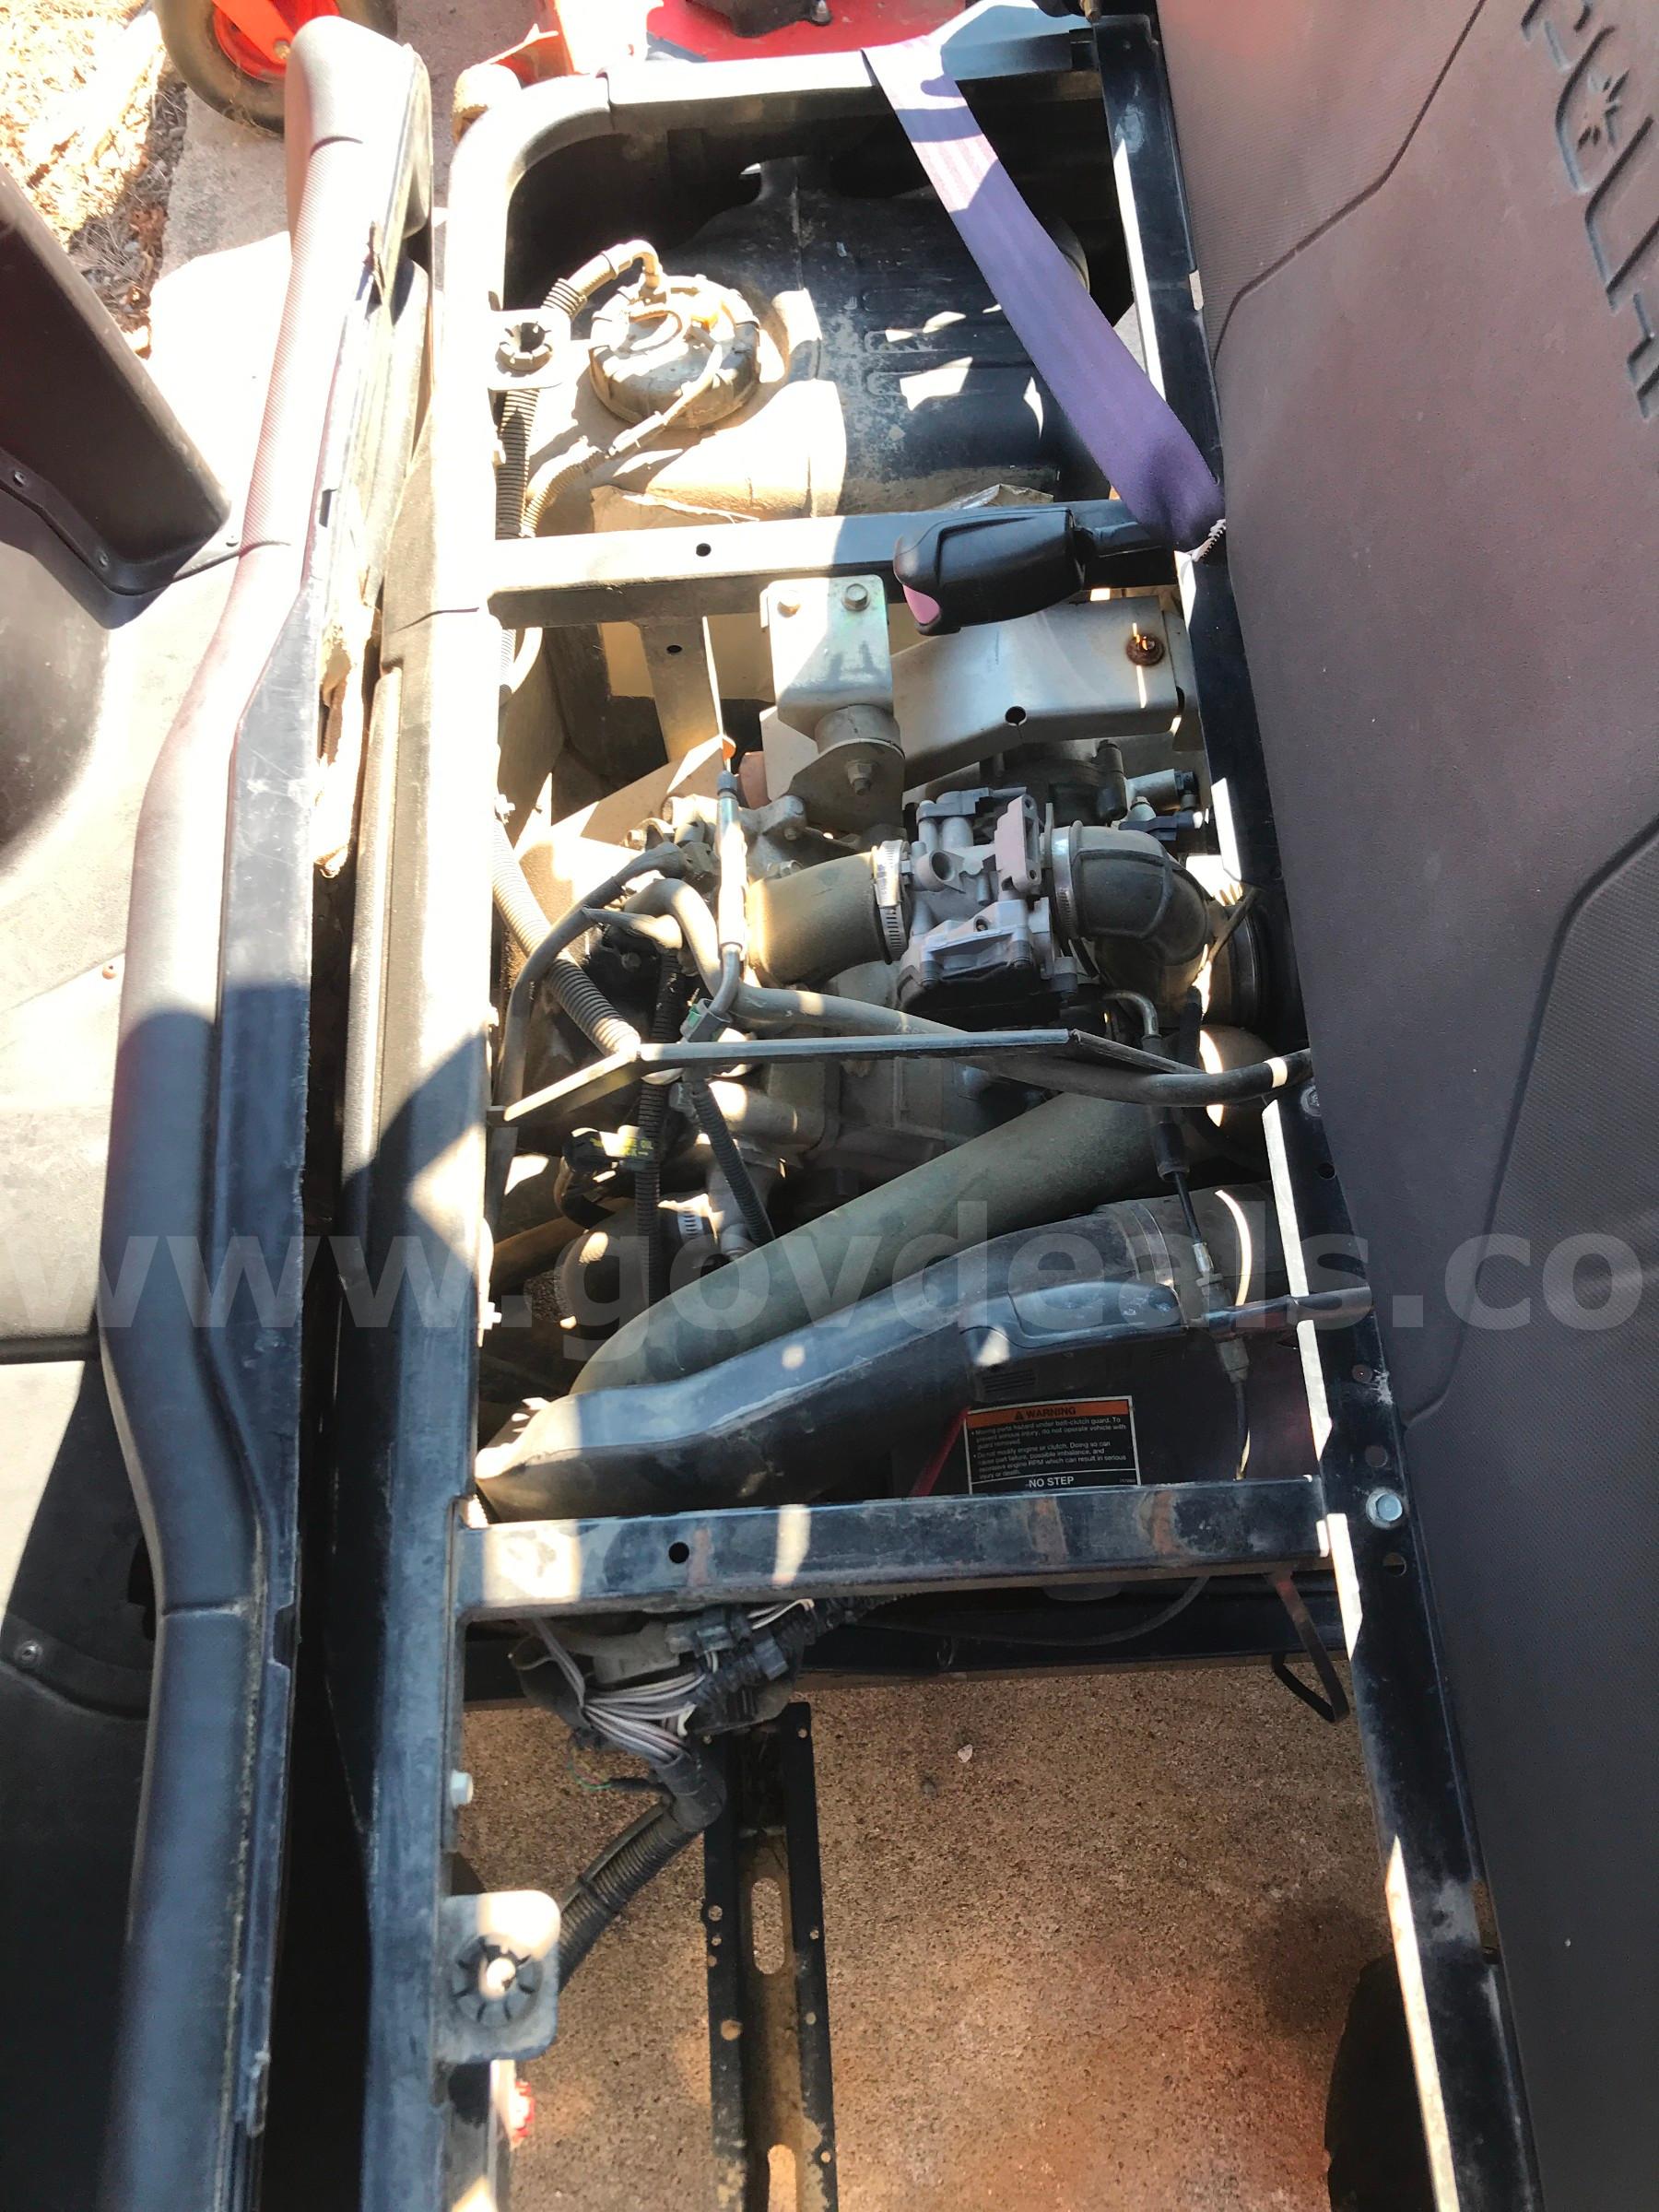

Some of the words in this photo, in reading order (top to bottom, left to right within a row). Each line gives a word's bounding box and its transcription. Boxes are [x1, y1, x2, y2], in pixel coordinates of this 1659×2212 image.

[1025, 1406, 1077, 1419] WARNING
[1029, 1477, 1044, 1488] NO
[1047, 1476, 1075, 1487] STEP
